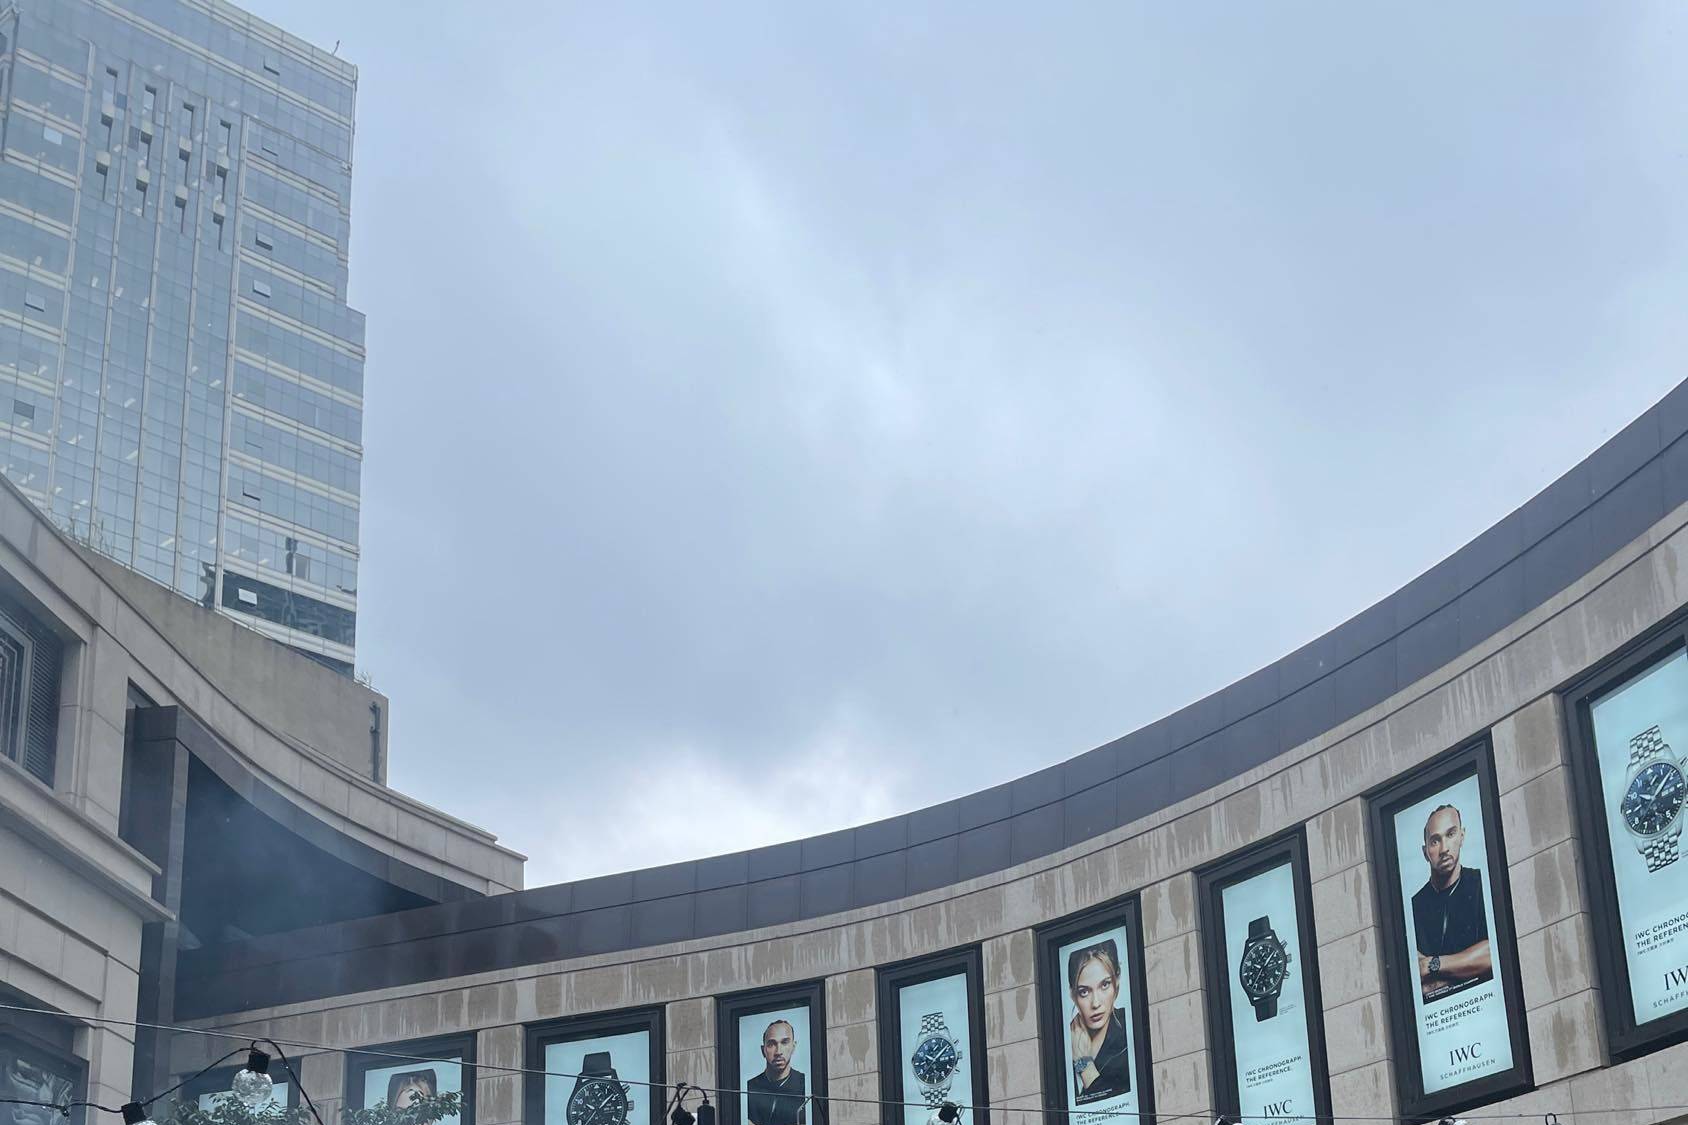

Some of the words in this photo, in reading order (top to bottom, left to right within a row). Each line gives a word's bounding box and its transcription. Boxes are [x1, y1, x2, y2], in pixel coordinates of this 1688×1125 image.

[1635, 929, 1651, 940] IWC
[1636, 938, 1651, 949] THE
[1425, 1012, 1438, 1021] IWC
[1426, 1021, 1439, 1029] THE
[1449, 1043, 1481, 1066] IWC
[1245, 1069, 1256, 1077] IWC
[1440, 1059, 1496, 1080] SCHAFFHAUSEN
[1264, 1100, 1293, 1119] IWC
